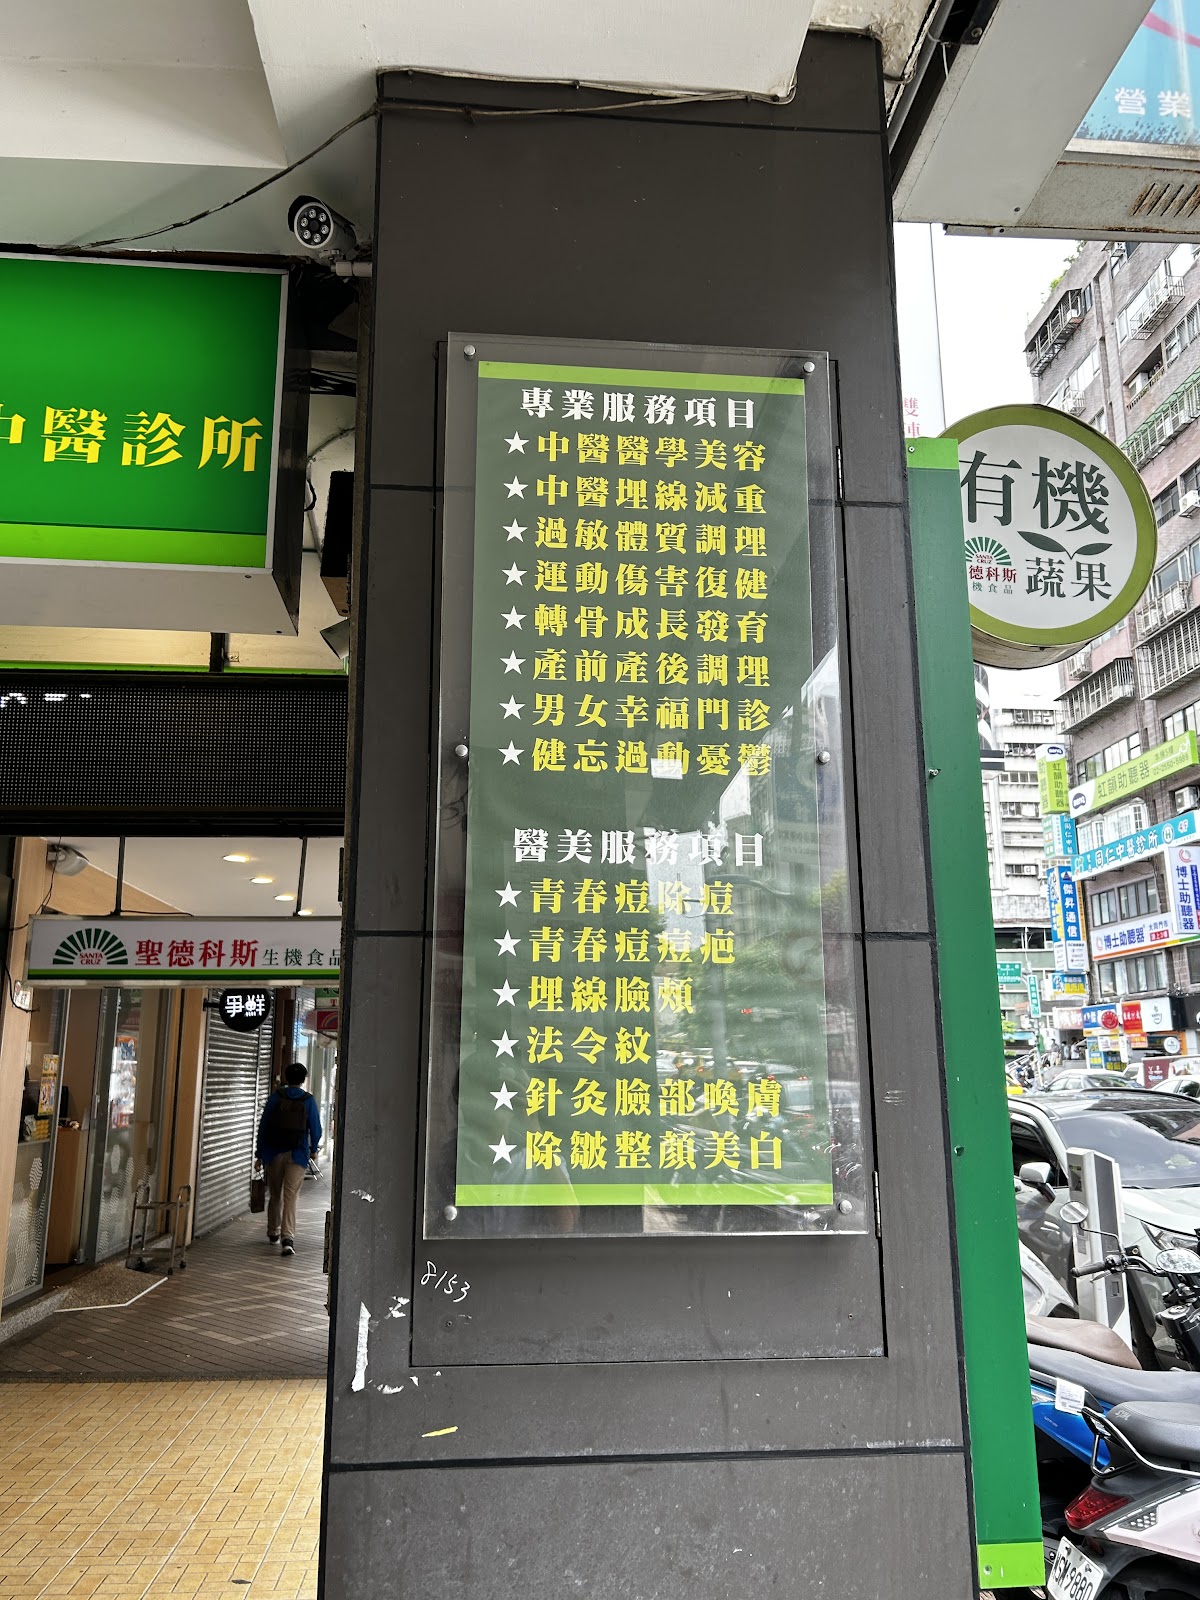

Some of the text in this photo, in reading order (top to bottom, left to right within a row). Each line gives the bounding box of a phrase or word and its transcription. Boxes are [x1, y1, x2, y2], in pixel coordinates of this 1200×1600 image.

[1114, 87, 1191, 118] 營業
[520, 387, 755, 429] 專業服務項目
[537, 431, 766, 472] 中醫醫學美容
[536, 474, 767, 514] 中醫埋線減重
[959, 450, 1110, 534] 有機
[534, 516, 768, 557] 過敏體質調理
[534, 559, 769, 600] 運動傷害復健
[1025, 557, 1113, 602] 蔬果
[533, 603, 769, 644] 轉骨成長發育
[532, 648, 771, 687] 產前產後調理
[532, 692, 772, 732] 男女幸福門診
[531, 737, 773, 777] 健忘過動憂鬱
[512, 827, 764, 867] 醫美服務項目
[529, 878, 735, 916] 青春痘除痘
[1175, 865, 1195, 931] 博士助聽器
[79, 952, 104, 960] SANTA
[135, 938, 259, 968] 聖德科斯
[528, 926, 736, 964] 青春痘痘疤
[1103, 926, 1145, 950] 博士助聽器
[80, 958, 102, 966] CRUZ
[527, 975, 694, 1015] 埋線臉頰
[527, 1026, 651, 1065] 法令紋
[525, 1077, 782, 1118] 針灸臉部喚膚
[525, 1130, 783, 1170] 除皺整顏美白
